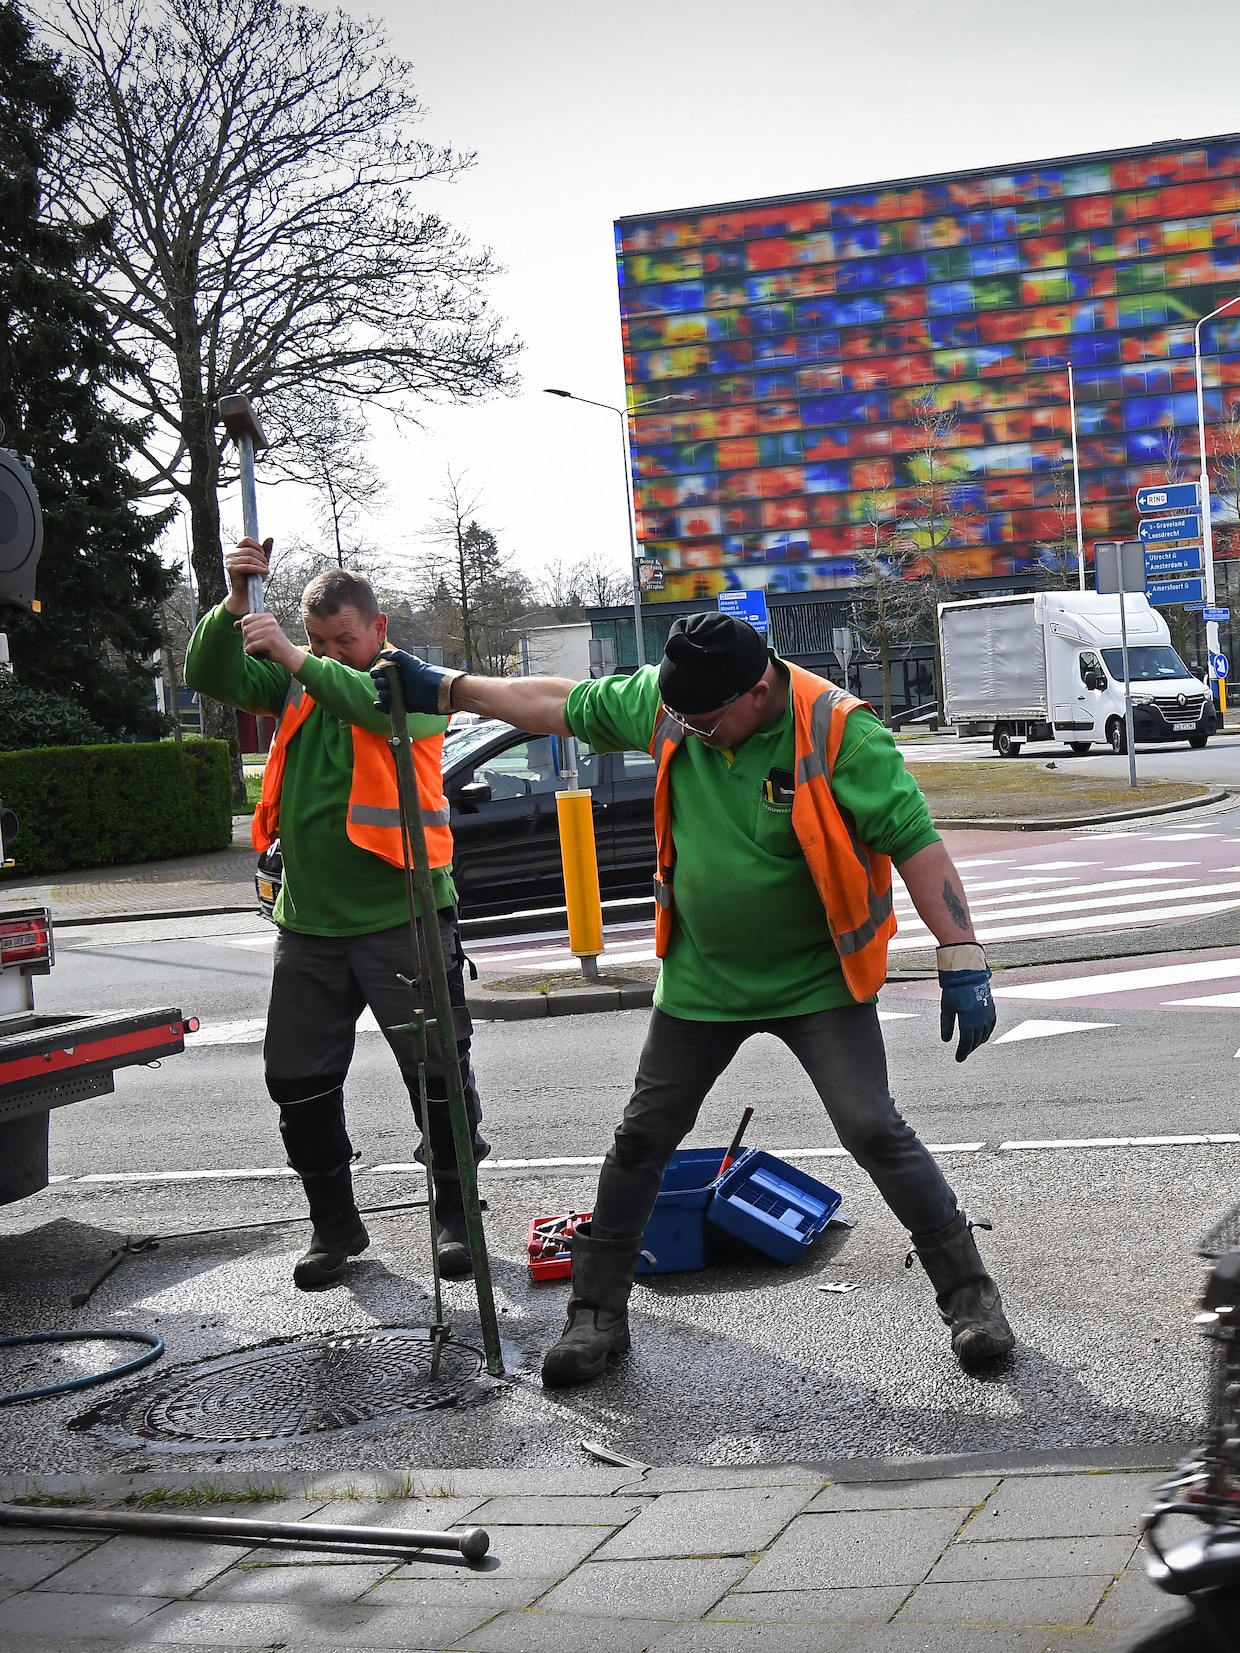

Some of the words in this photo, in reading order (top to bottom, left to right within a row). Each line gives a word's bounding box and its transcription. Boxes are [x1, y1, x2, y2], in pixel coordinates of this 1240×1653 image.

[1148, 495, 1165, 503] RING
[1148, 520, 1185, 529] 's-Graveland
[1148, 530, 1180, 539] Loosdrecht
[1149, 553, 1171, 561] Utrecht
[1150, 561, 1183, 570] Amsterdam
[1152, 583, 1184, 592] Amersfoort
